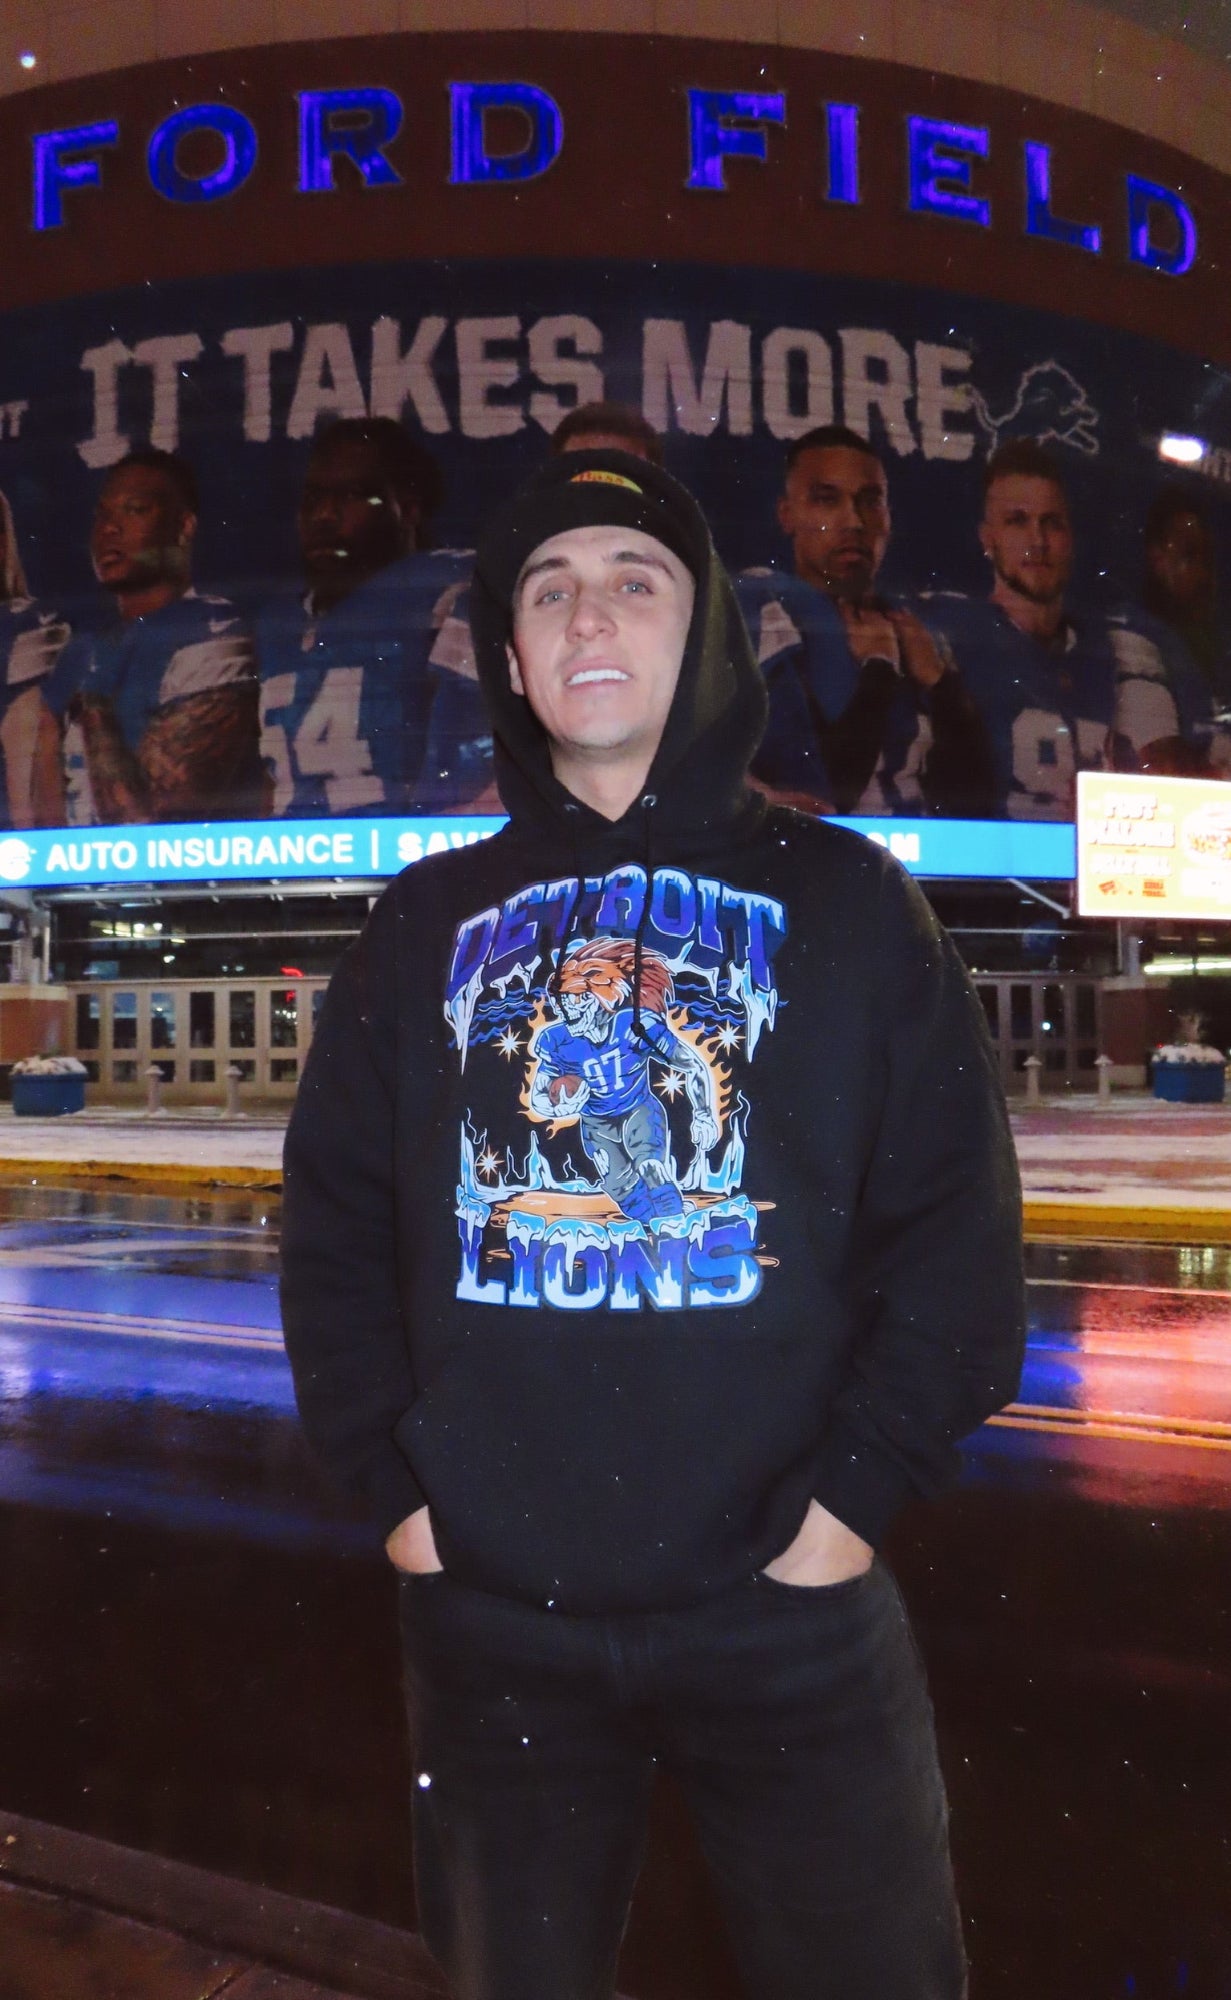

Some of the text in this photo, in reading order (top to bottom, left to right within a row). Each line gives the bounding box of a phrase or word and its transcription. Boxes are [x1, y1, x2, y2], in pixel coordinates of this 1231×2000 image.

[33, 82, 1198, 276] FORD FIELD
[77, 315, 976, 469] IT TAKES MORE
[46, 841, 138, 873] AUTO
[147, 834, 354, 869] INSURANCE
[445, 864, 788, 1002] DETROIT
[582, 1047, 625, 1094] 97
[456, 1195, 762, 1311] LIONS
